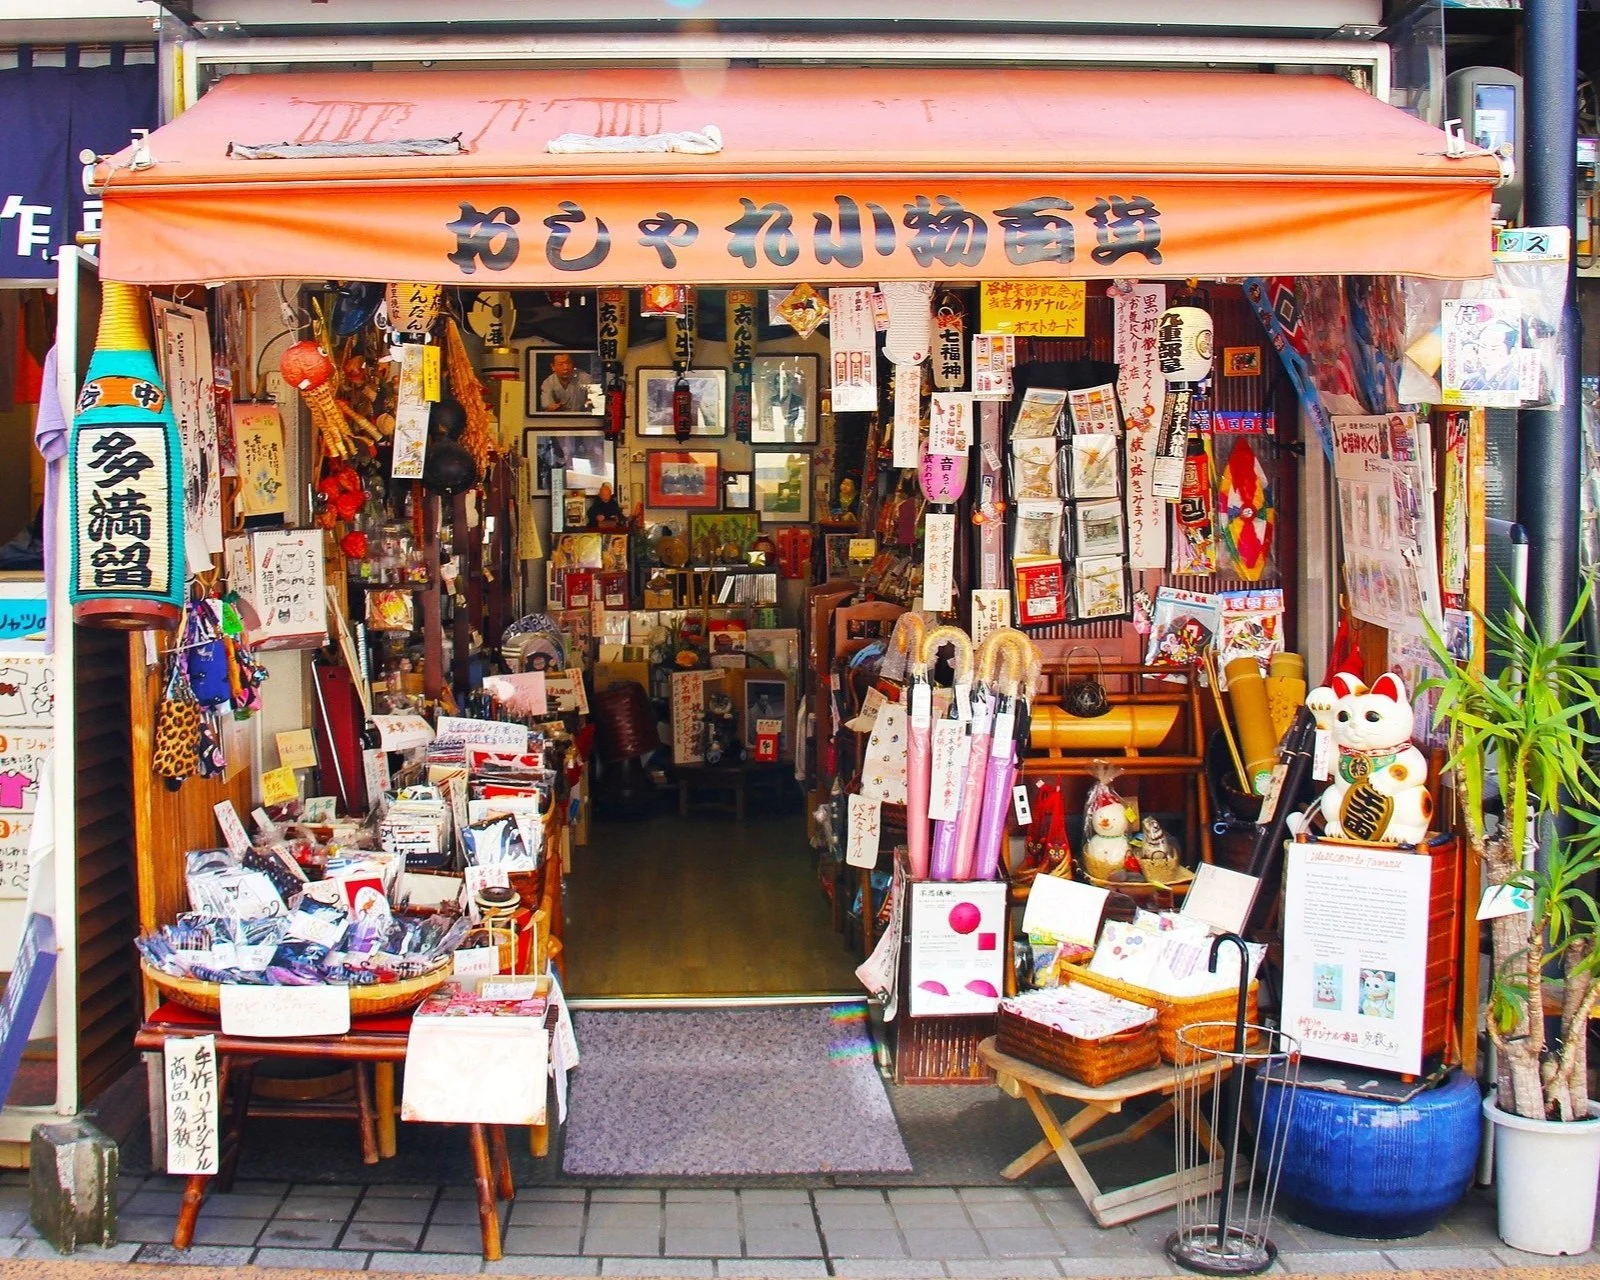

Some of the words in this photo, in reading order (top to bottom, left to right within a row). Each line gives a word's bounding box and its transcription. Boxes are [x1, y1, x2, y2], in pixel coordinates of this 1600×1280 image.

[446, 195, 1163, 274] おしゃれ小物百貨
[733, 304, 752, 361] 志ん生
[939, 328, 961, 380] 七福神
[1012, 317, 1077, 335] ポストカード
[1128, 295, 1142, 380] お気に入りの店
[1168, 392, 1190, 457] 新弟子大募集
[939, 456, 954, 496] 音ちゃん
[1130, 436, 1147, 558] 綾小路きみまろさん
[88, 431, 155, 588] 多満留
[852, 803, 867, 858] バスタオル
[867, 803, 877, 837] ガーゼ
[190, 1046, 214, 1171] 手作りオリジナル
